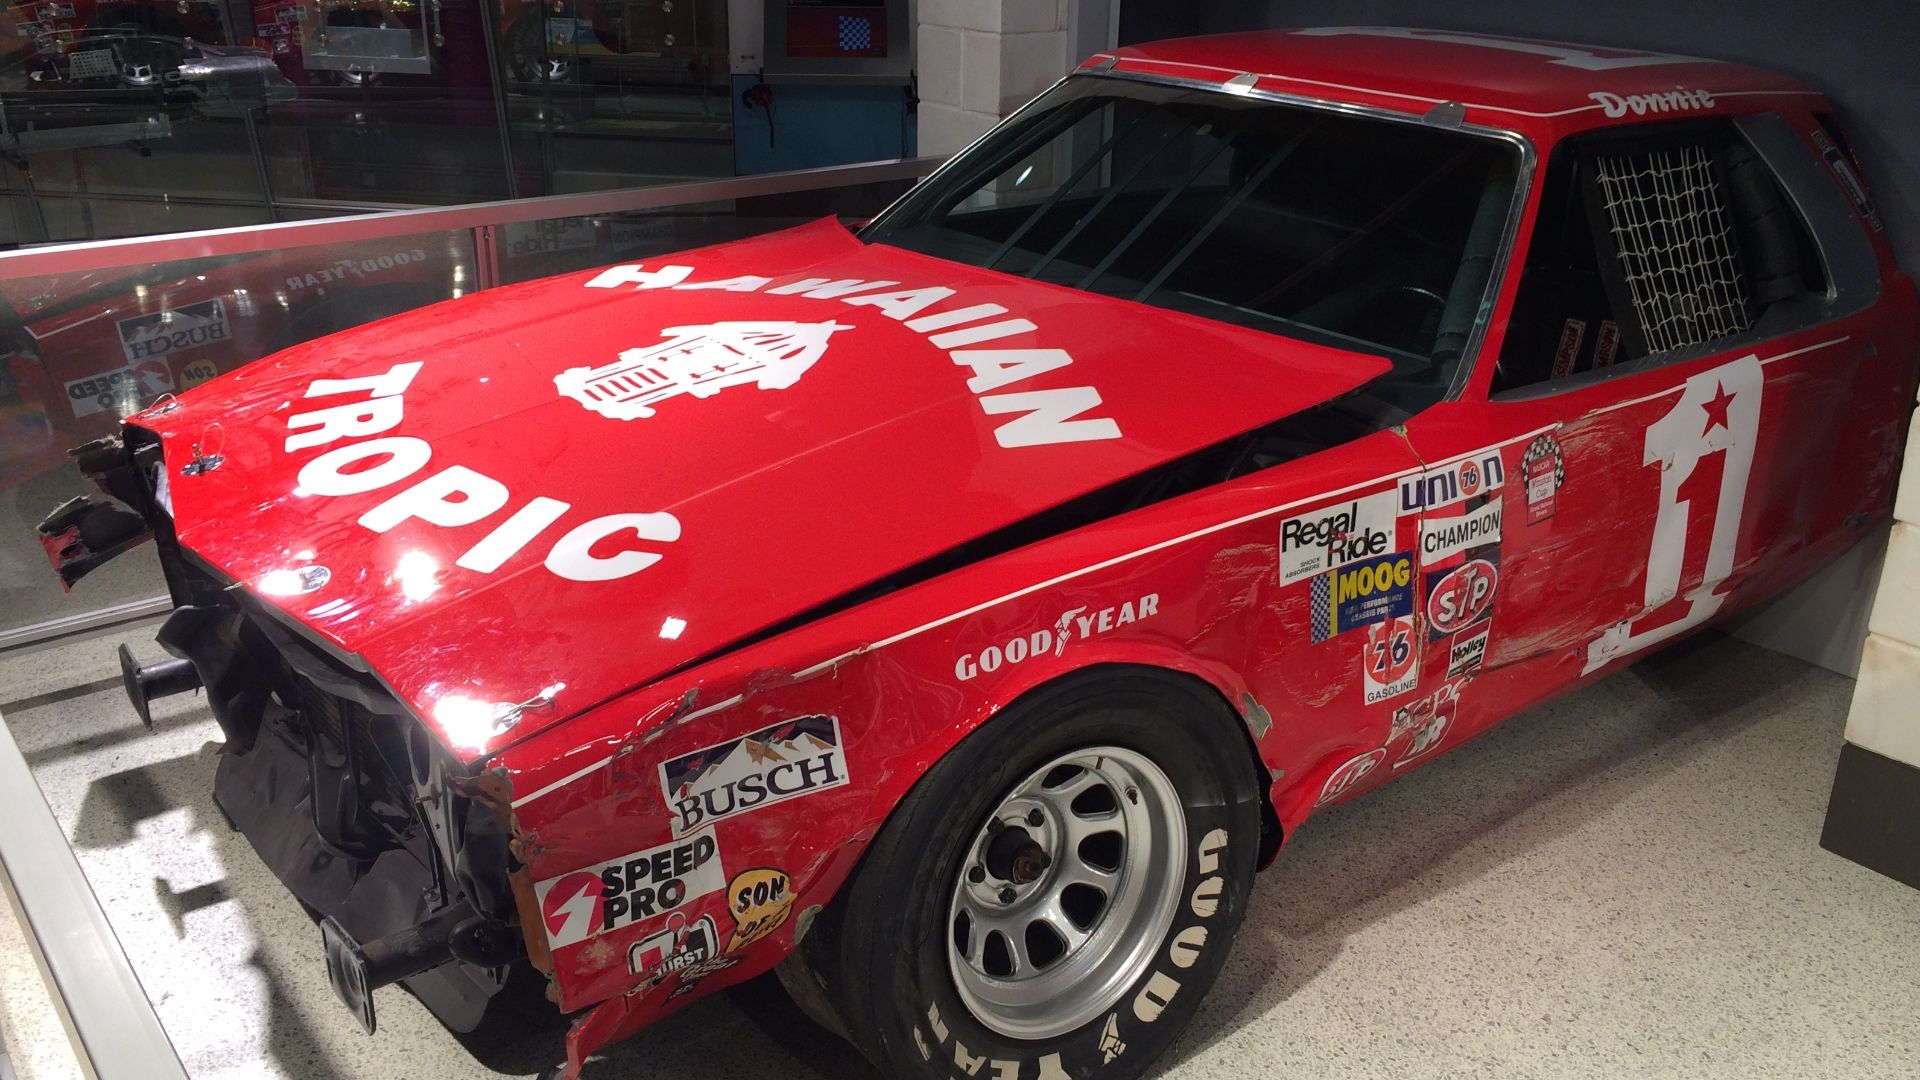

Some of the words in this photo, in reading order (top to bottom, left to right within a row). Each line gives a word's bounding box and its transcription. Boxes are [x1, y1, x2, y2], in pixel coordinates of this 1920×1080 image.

[1588, 85, 1714, 118] Donnie
[583, 264, 1123, 448] HAWAIIAN
[284, 361, 682, 582] TROPIC
[1282, 502, 1357, 553] Regal
[1328, 527, 1388, 567] Ride
[1424, 510, 1500, 553] CHAMPION
[1285, 563, 1320, 579] ABSORBERS
[1300, 556, 1321, 568] SHOCK
[1339, 558, 1410, 604] MOOG
[1438, 567, 1489, 624] STP
[1373, 629, 1410, 674] 76
[1451, 636, 1486, 664] Holley
[1367, 678, 1416, 702] GASOLINE
[675, 752, 840, 832] BUSCH
[601, 834, 715, 899] SPEED
[602, 879, 686, 931] PRO
[737, 876, 785, 913] SON
